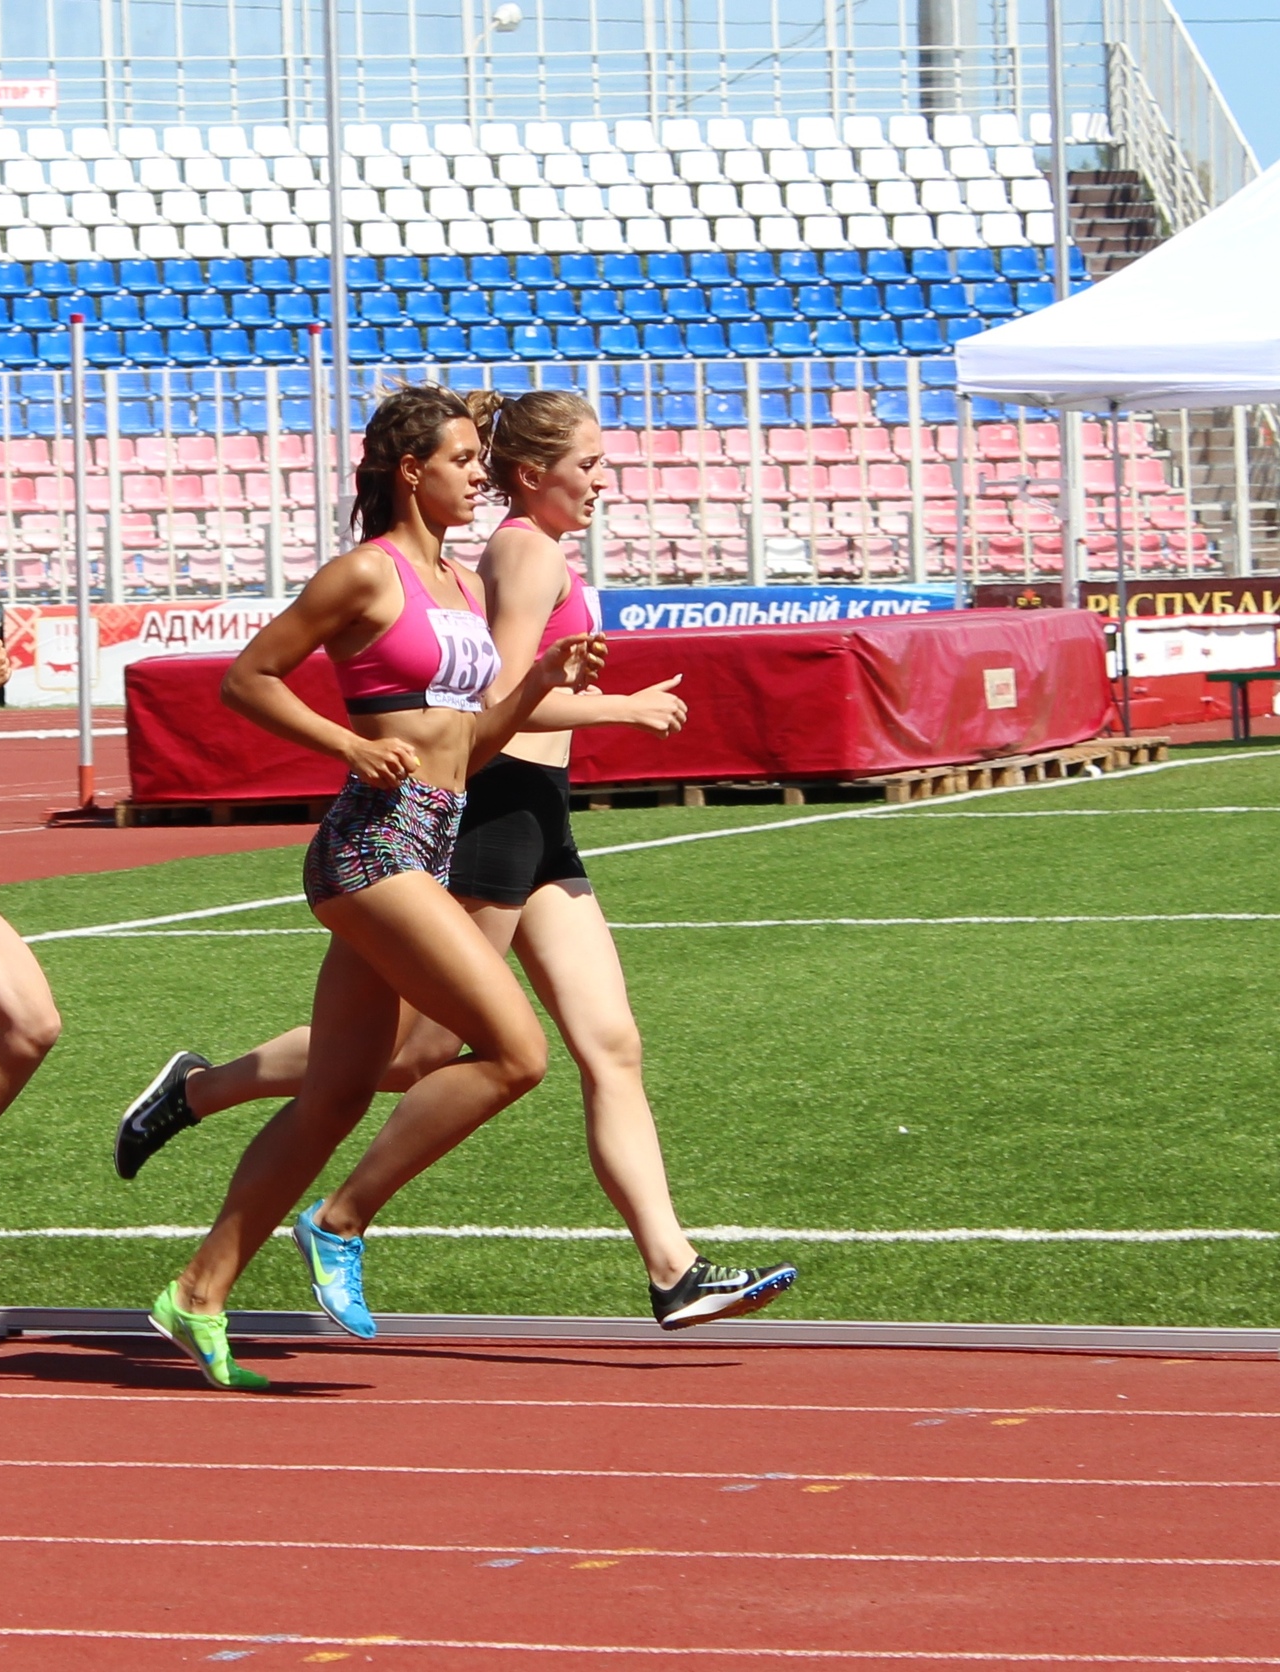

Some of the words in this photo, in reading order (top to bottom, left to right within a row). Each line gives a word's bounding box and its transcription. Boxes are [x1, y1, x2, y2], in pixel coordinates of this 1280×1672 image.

[619, 594, 838, 630] ФУТБОЛЬНЫЙ
[1086, 589, 1280, 617] РЕСПУБЛИ
[143, 612, 274, 646] АДМИН
[440, 635, 494, 692] 137
